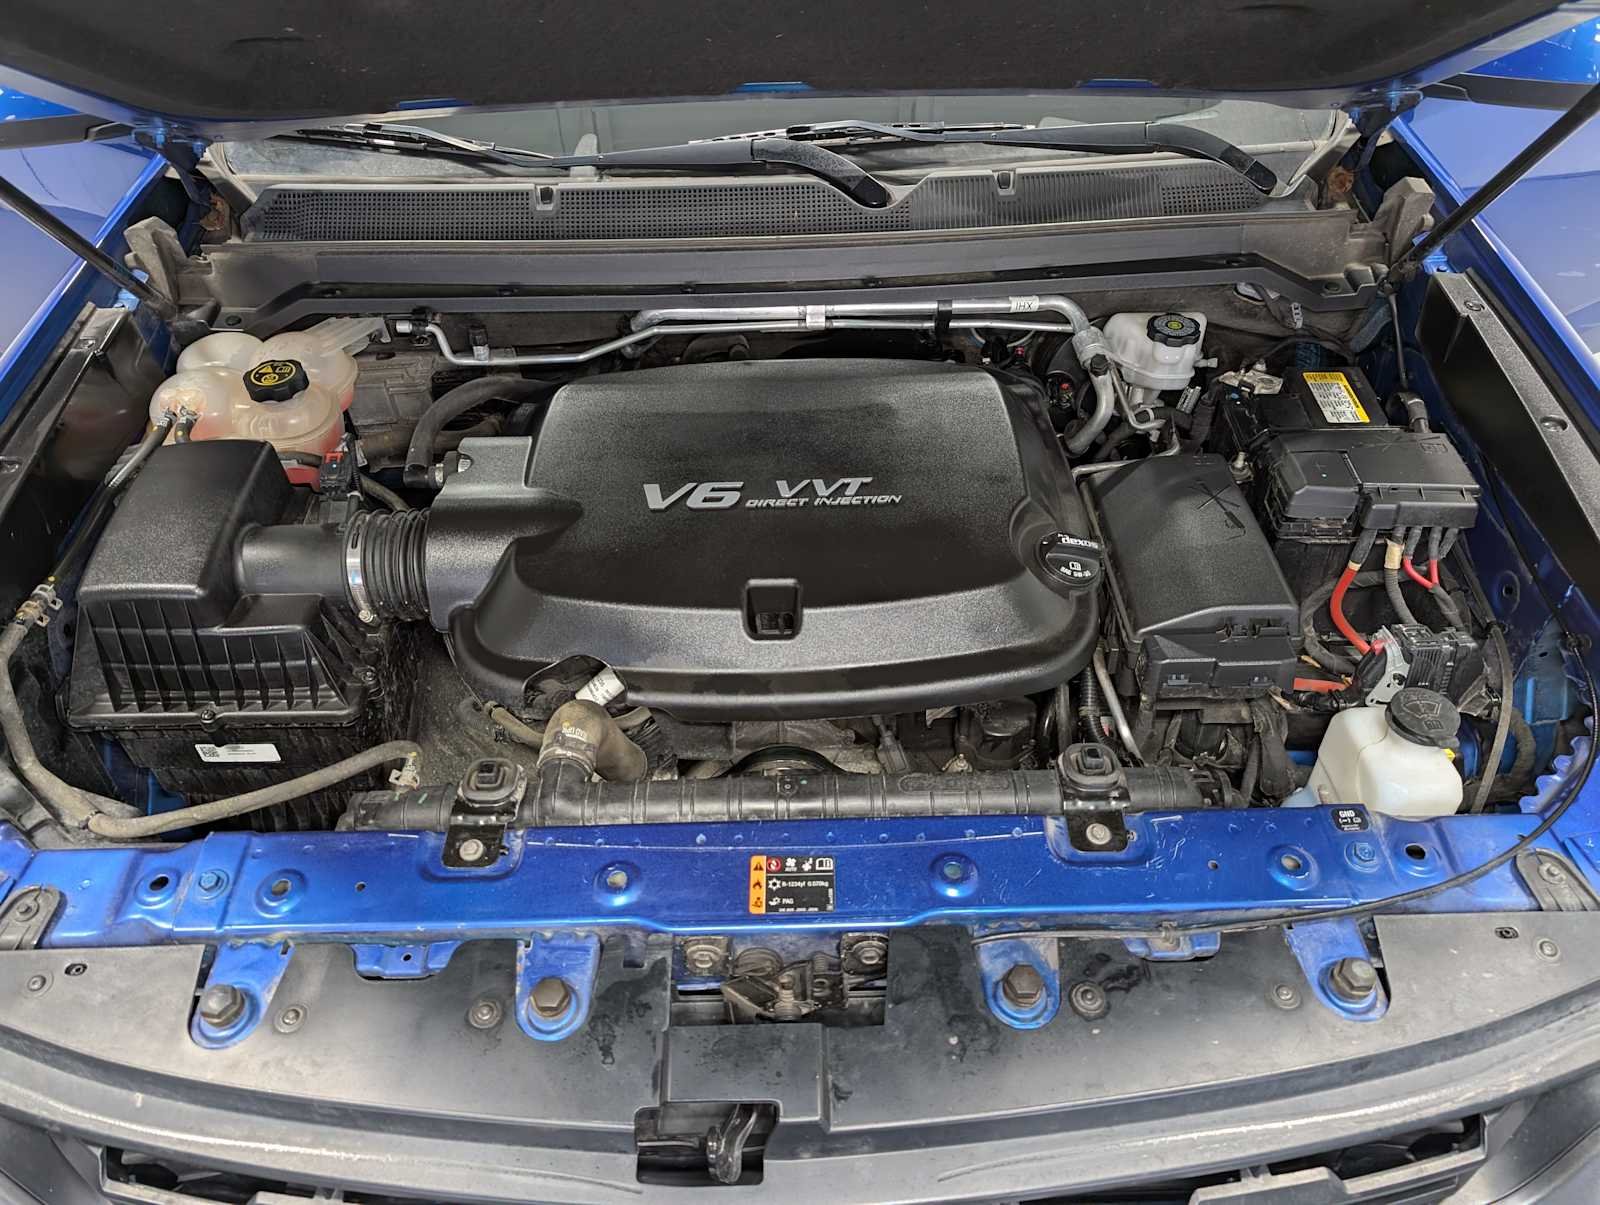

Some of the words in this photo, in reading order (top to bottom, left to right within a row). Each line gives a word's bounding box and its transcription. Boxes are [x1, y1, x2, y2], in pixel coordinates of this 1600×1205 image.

[643, 481, 744, 510] V6
[776, 477, 873, 498] VVT
[745, 497, 809, 508] DIRECT
[814, 494, 902, 507] INJECTION
[1062, 535, 1099, 549] dexos
